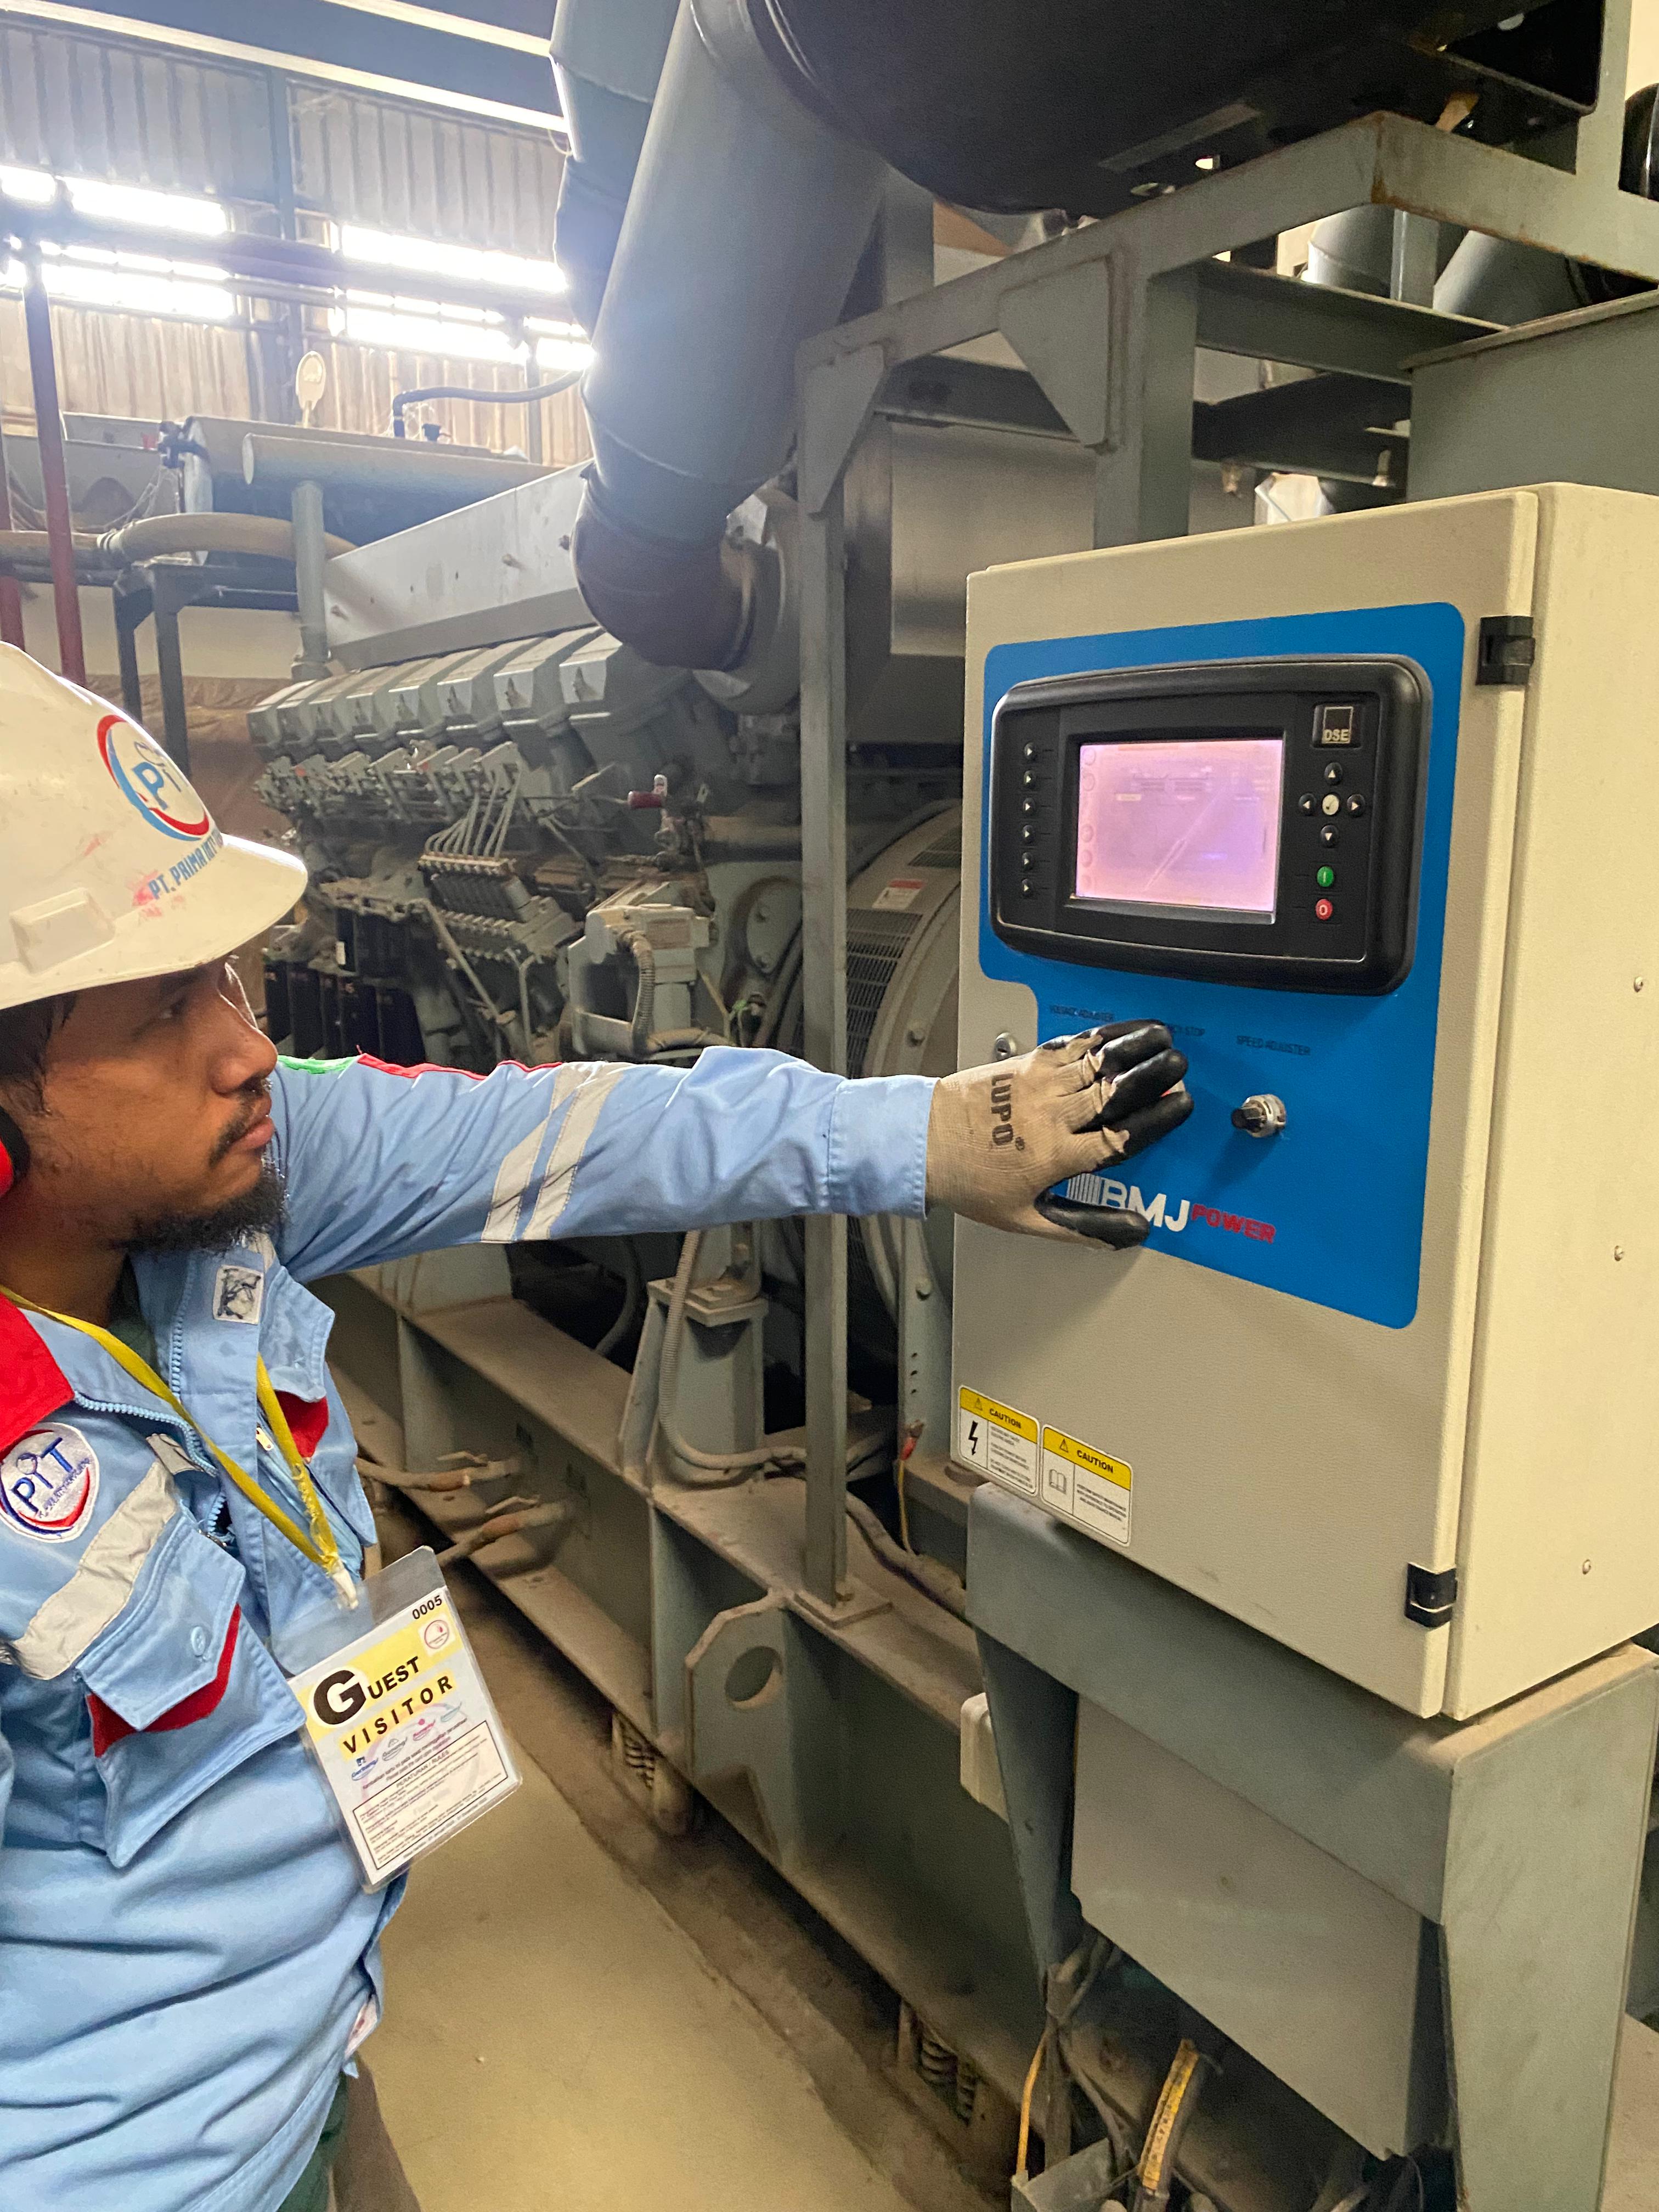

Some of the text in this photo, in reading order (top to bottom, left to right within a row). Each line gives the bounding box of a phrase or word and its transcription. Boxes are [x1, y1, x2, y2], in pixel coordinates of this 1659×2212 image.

[1322, 729, 1351, 742] DSE
[149, 874, 176, 900] PT.
[1237, 1035, 1311, 1056] SPEED ADJUSTER
[1190, 1203, 1277, 1245] POWER
[989, 1407, 1022, 1430] CAUTION
[1076, 1449, 1114, 1474] CAUTION
[412, 1595, 442, 1620] 0005
[313, 1656, 419, 1725] GUEST
[343, 1675, 453, 1754] VISITOR
